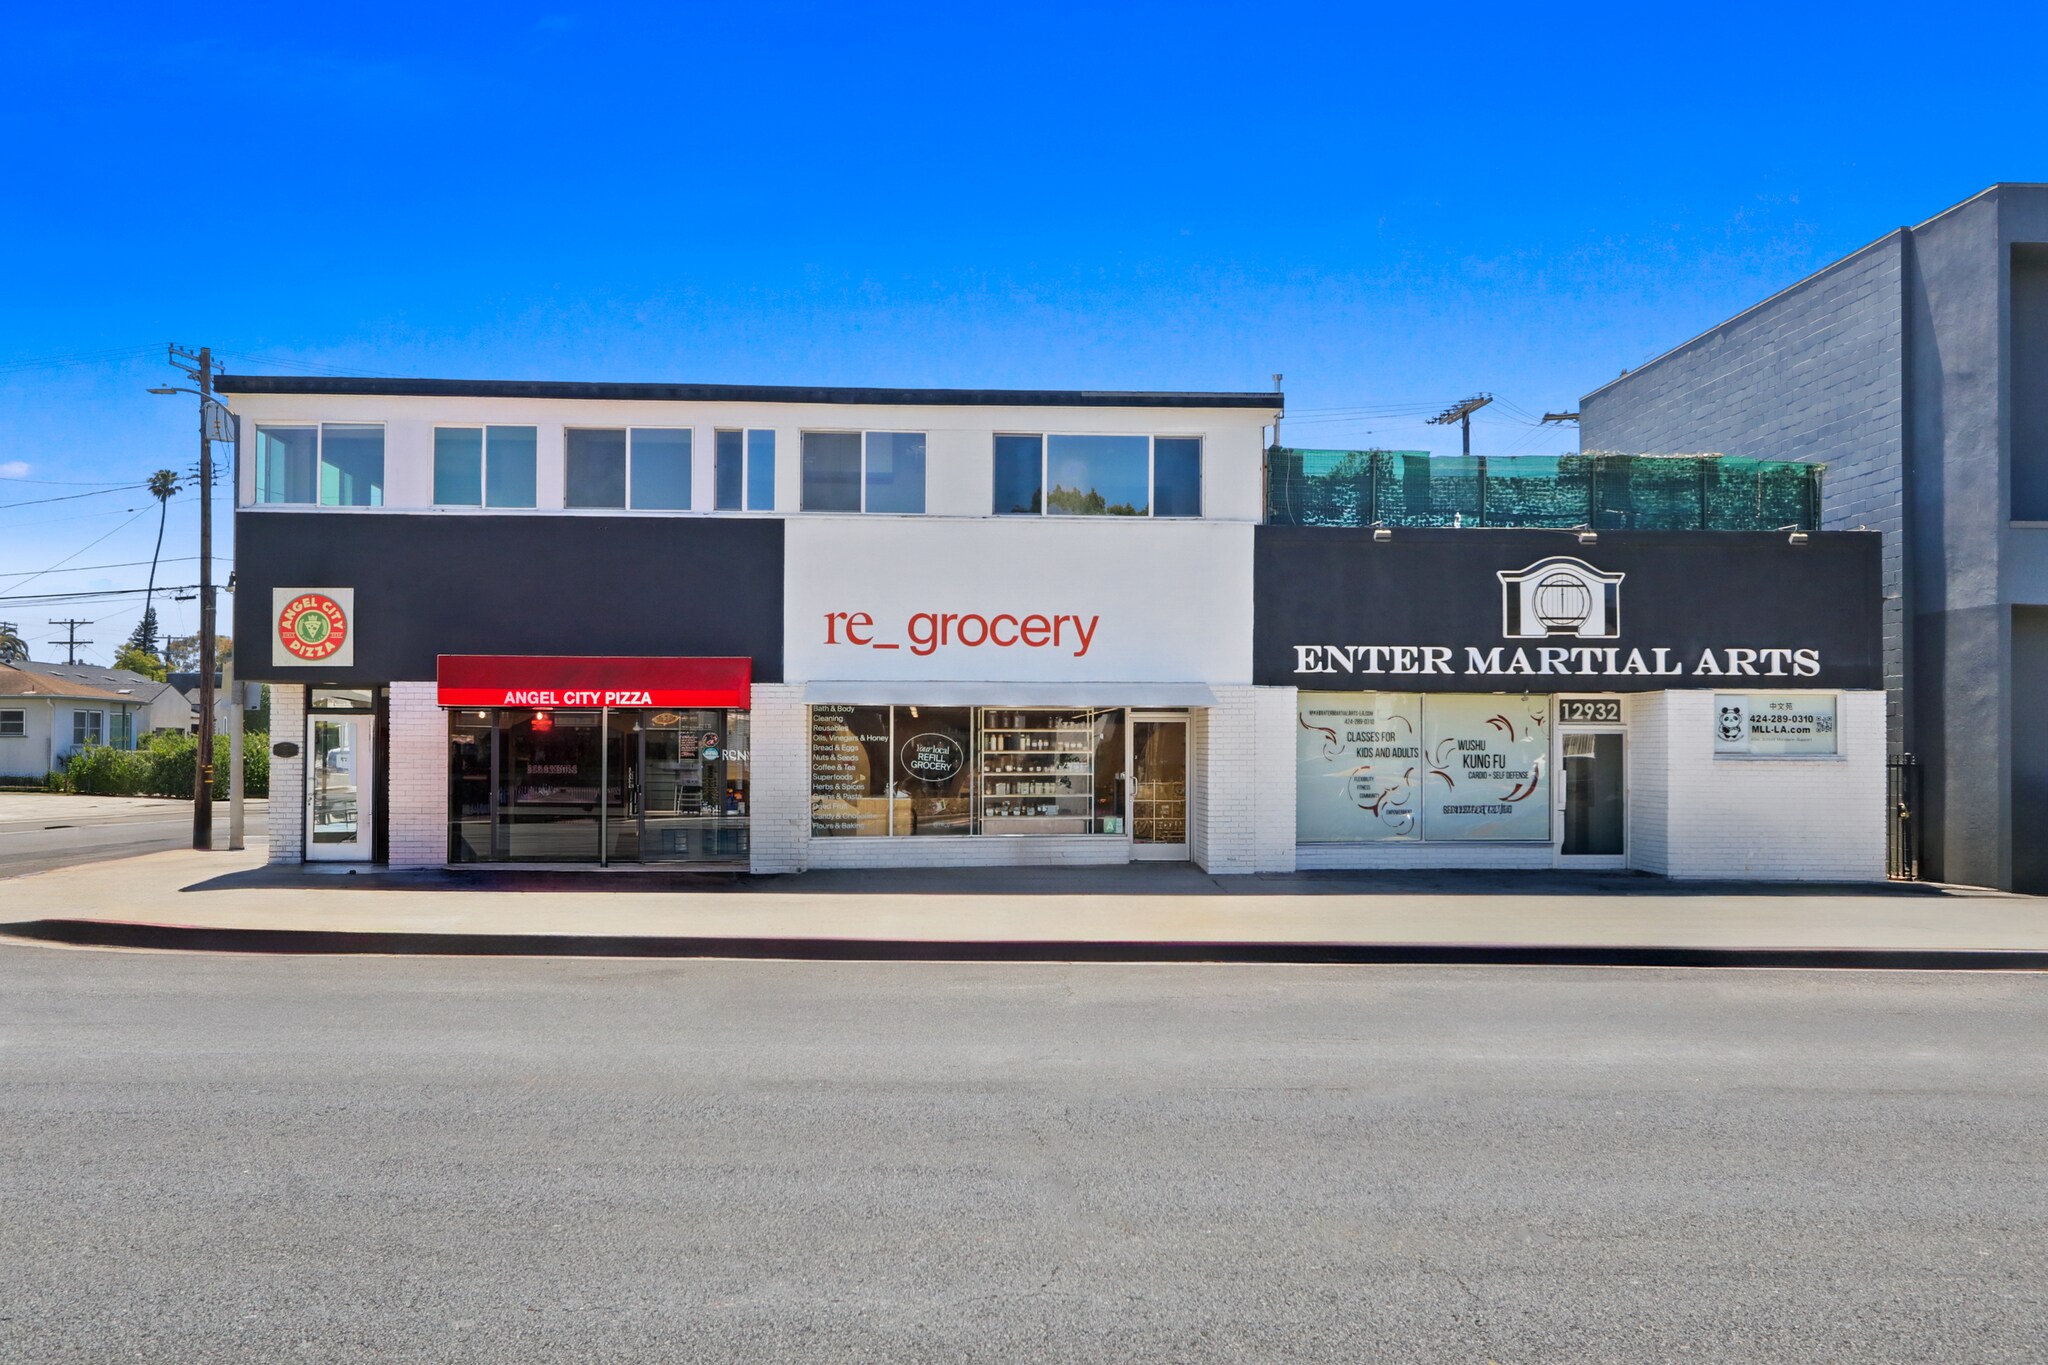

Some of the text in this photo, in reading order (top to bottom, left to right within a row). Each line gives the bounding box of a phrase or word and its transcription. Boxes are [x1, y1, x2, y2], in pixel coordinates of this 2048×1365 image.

[282, 597, 344, 630] ANGEL CITY
[907, 612, 1100, 657] grocery
[289, 640, 336, 657] PIZZA
[1293, 645, 1821, 677] ENTER MARTIAL ARTS
[503, 691, 652, 705] ANGEL CITY PIZZA
[837, 705, 855, 714] Body
[1562, 703, 1618, 720] 12932
[1769, 702, 1793, 711] 中文苑
[1750, 714, 1814, 723] 424-289-0310
[813, 724, 849, 732] Reusables
[1752, 725, 1811, 734] MLL-LA.com
[829, 735, 859, 743] Vinegars
[866, 735, 889, 743] Honey
[1346, 731, 1396, 742] CLASSES FOR
[841, 744, 859, 753] Eggs
[932, 745, 950, 755] local
[1457, 740, 1486, 751] WUSHU
[917, 752, 946, 763] REFILL
[1356, 747, 1419, 759] KIDS AND ADULTS
[910, 760, 952, 771] GROCERY
[1463, 754, 1506, 769] KUNG FU
[813, 763, 856, 771] Coffee & Tea
[813, 773, 853, 781] Superfoods
[1468, 771, 1529, 780] CARDIO SELF DEFENSE
[841, 783, 865, 791] Spices
[841, 822, 865, 831] Baking
[1106, 821, 1114, 831] A
